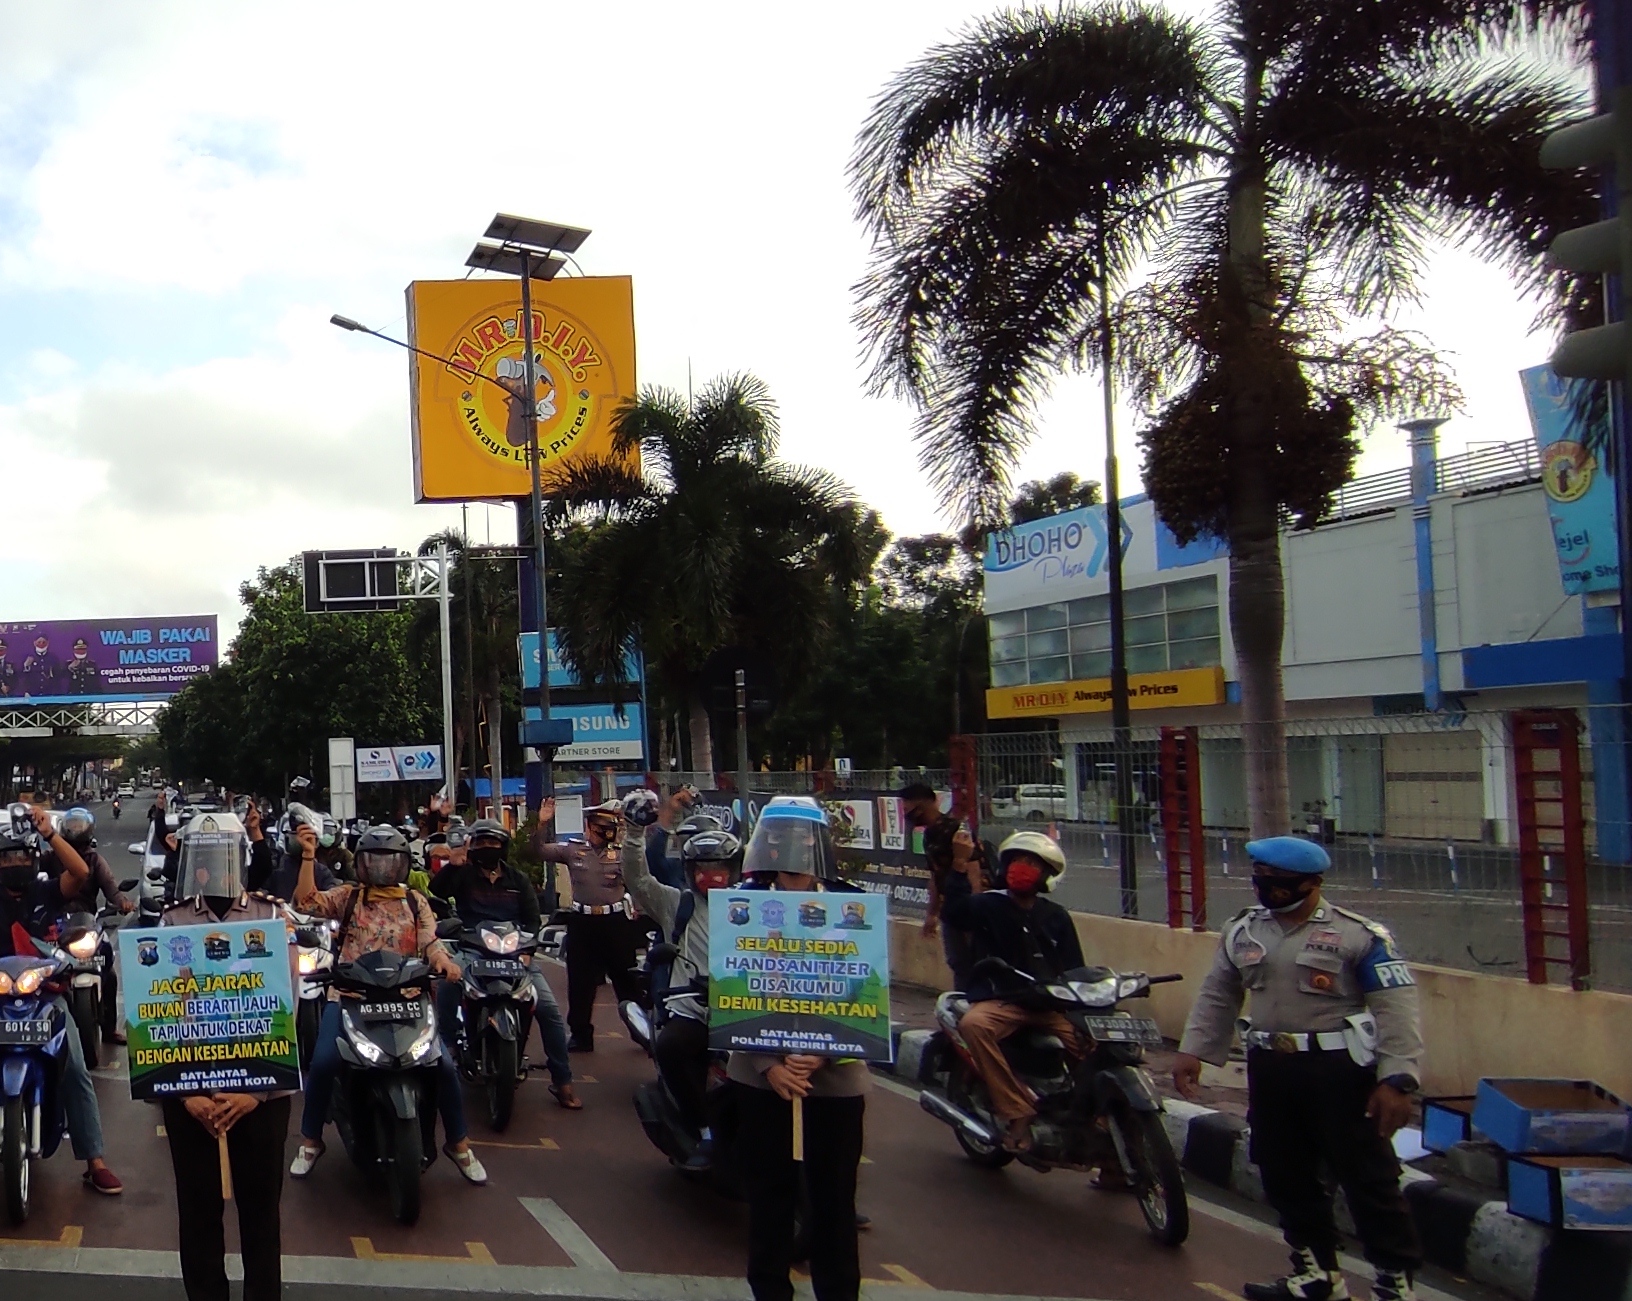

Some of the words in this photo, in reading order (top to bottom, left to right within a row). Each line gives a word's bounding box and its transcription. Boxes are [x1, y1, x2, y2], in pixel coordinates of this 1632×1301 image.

[464, 407, 509, 457] Always
[549, 406, 587, 454] Prices
[996, 523, 1083, 566] DHOHO
[1557, 529, 1589, 551] ejel
[1562, 571, 1591, 582] ome
[1595, 565, 1619, 577] Sho
[100, 629, 152, 645] WAJIB
[159, 627, 211, 644] PAKAI
[119, 647, 191, 665] MASKER
[101, 667, 124, 677] cegah
[125, 666, 170, 676] penyebaran
[171, 665, 210, 673] COVID-19
[108, 676, 131, 684] untuk
[1073, 690, 1112, 701] Always
[1140, 683, 1179, 697] Prices
[574, 715, 630, 731] SUNG
[554, 748, 589, 757] ARTNER
[592, 747, 620, 755] STORE
[885, 836, 901, 847] KFC
[735, 936, 801, 953] SELALU
[804, 939, 859, 956] SEDIA
[724, 956, 871, 978] HANDSANITIZER
[149, 977, 199, 996] JAGA
[203, 972, 265, 992] JARAK
[749, 976, 845, 996] DISAKUMU
[138, 1001, 185, 1019] BUKAN
[187, 998, 241, 1015] BERARTI
[243, 995, 279, 1012] JAUH
[360, 1004, 372, 1013] AG
[376, 1003, 404, 1013] 3995
[407, 1002, 420, 1011] CC
[719, 995, 763, 1011] DEMI
[766, 998, 877, 1018] KESEHATAN
[5, 1022, 30, 1032] 6014
[149, 1024, 180, 1041] TAPI
[180, 1021, 225, 1039] UNTUK
[228, 1018, 272, 1035] DEKAT
[760, 1029, 834, 1041] SATLANTAS
[136, 1047, 192, 1065] DENGAN
[193, 1040, 289, 1062] KESELAMATAN
[731, 1036, 780, 1047] POLRES
[782, 1040, 826, 1050] KEDIRI
[829, 1042, 865, 1053] KOTA
[180, 1068, 247, 1080] SATLANTAS
[153, 1082, 199, 1092] POLRES
[202, 1079, 242, 1088] KEDIRI
[245, 1076, 277, 1086] KOTA
